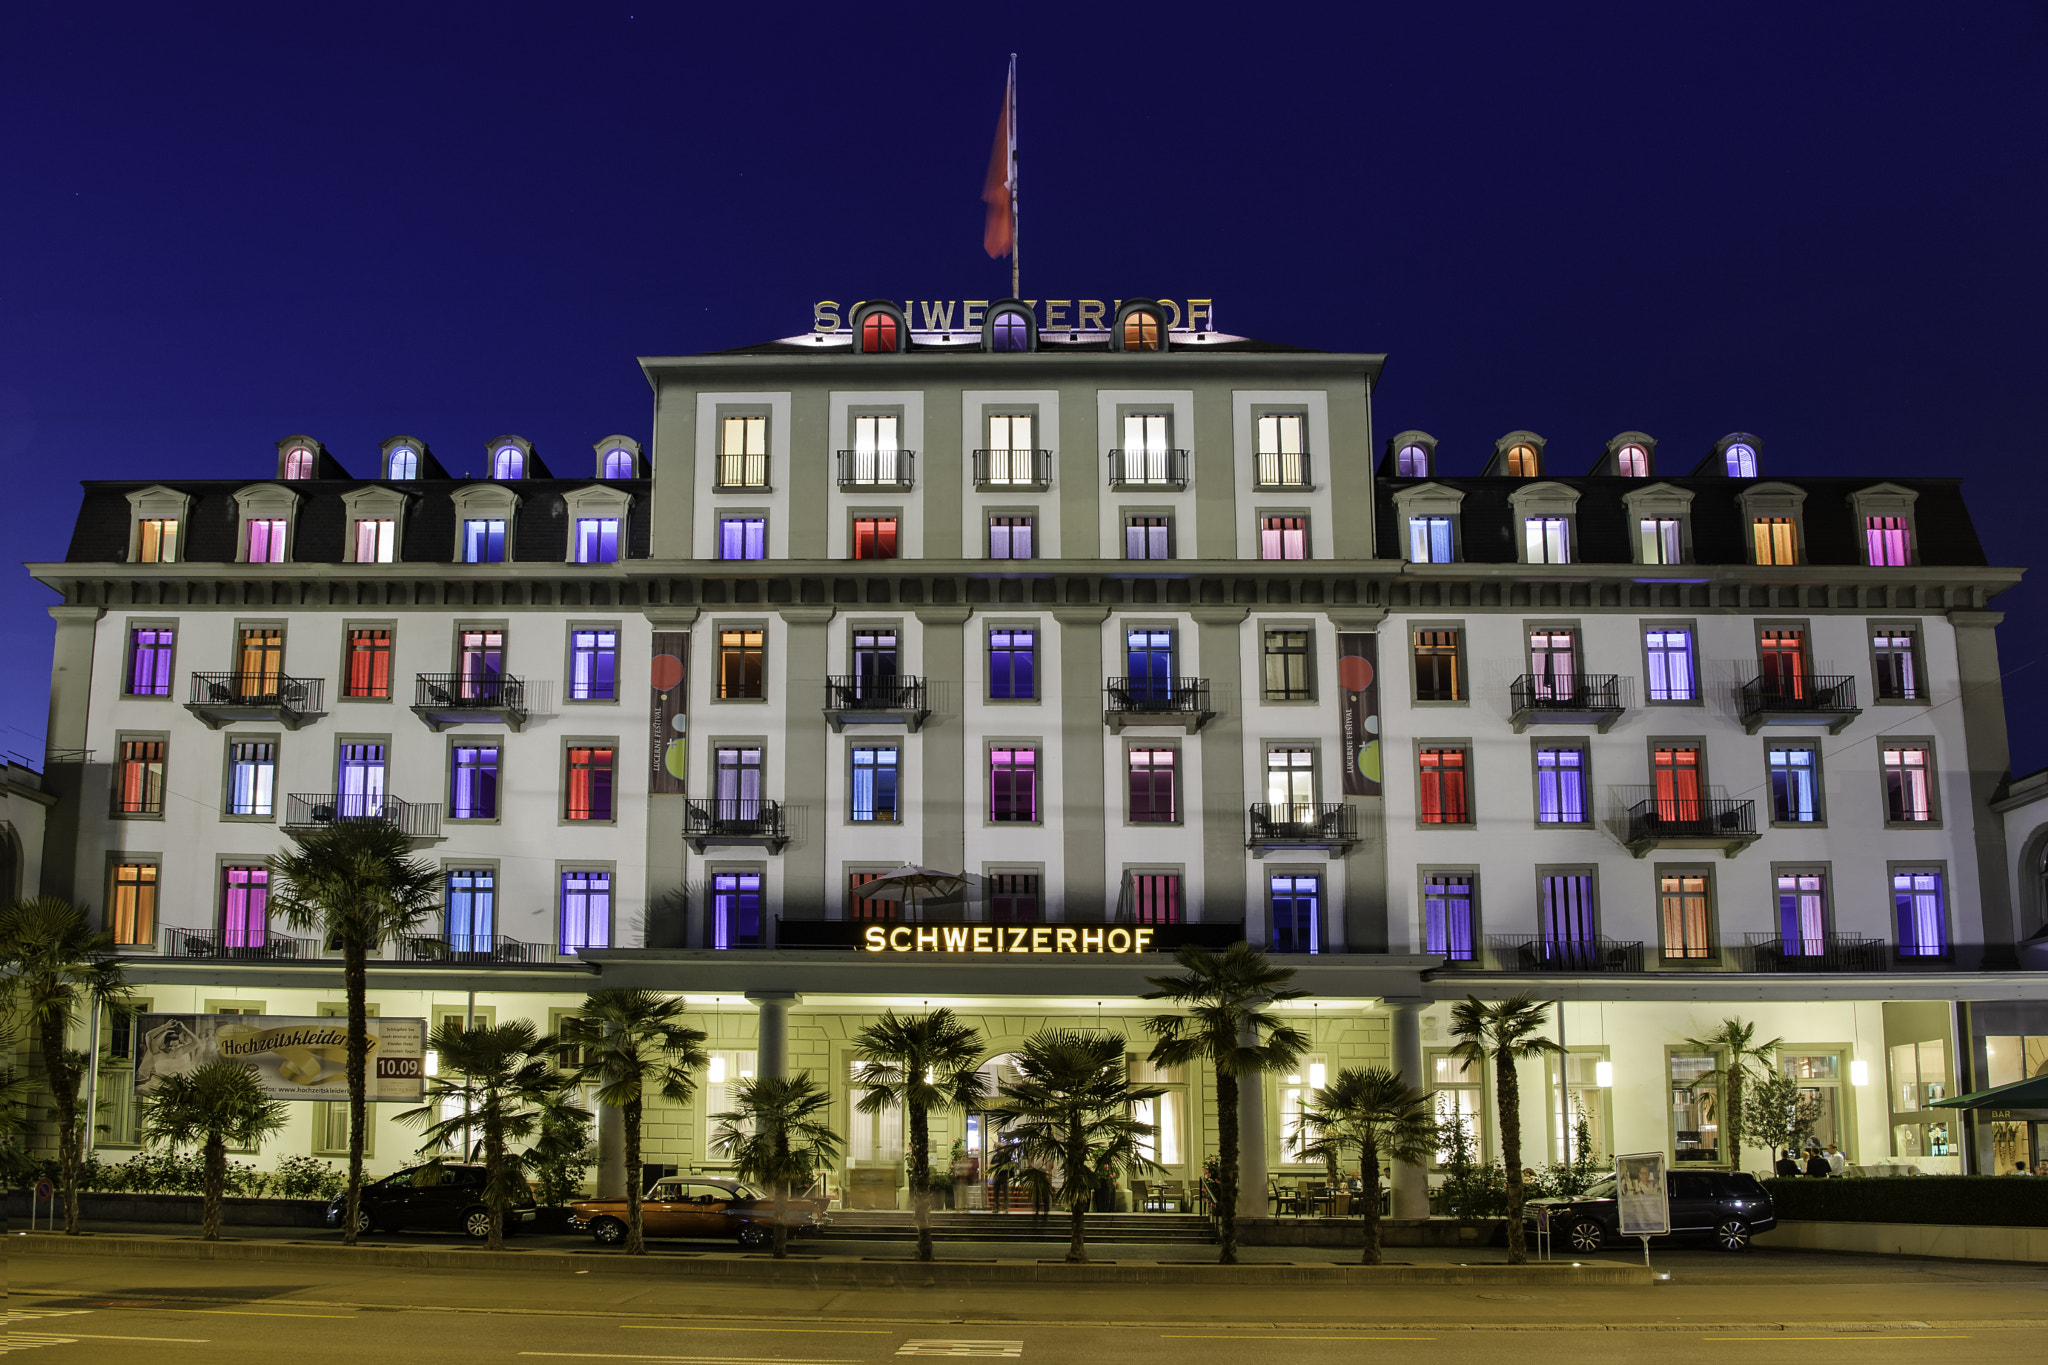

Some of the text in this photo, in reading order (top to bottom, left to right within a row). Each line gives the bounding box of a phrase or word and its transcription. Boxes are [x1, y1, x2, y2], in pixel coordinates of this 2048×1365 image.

[1345, 708, 1353, 739] FESTIVAL
[653, 707, 662, 771] LUCERNE FESTIVAL
[865, 926, 1154, 953] SCHWEIZERHOF
[379, 1060, 422, 1075] 10.09.
